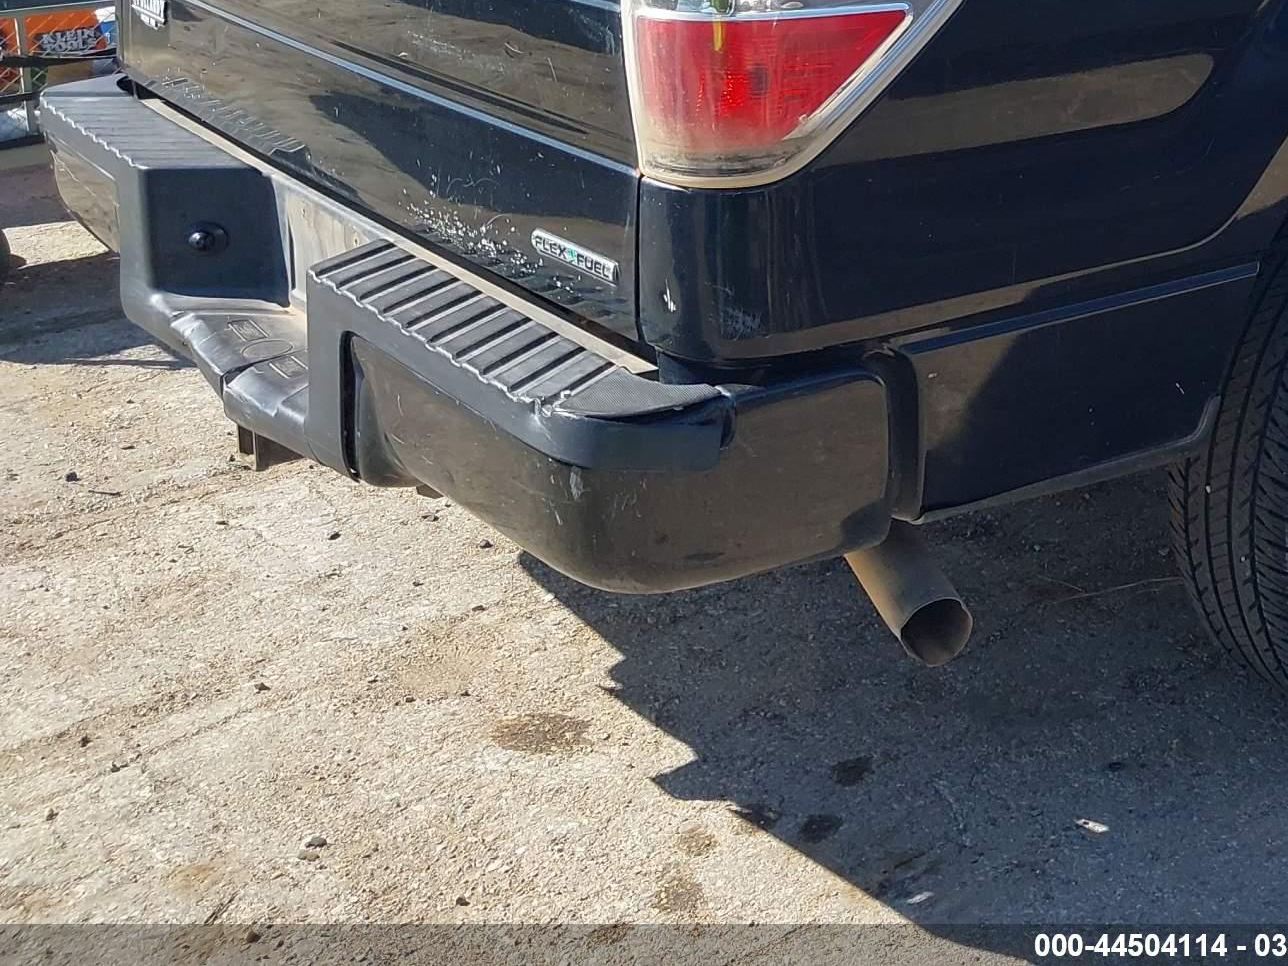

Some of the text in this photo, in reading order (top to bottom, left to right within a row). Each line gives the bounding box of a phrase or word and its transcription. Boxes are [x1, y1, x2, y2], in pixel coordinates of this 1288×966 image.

[41, 27, 96, 44] KLEIN
[43, 37, 97, 52] TOOLS
[533, 235, 611, 279] FLEX FUEL
